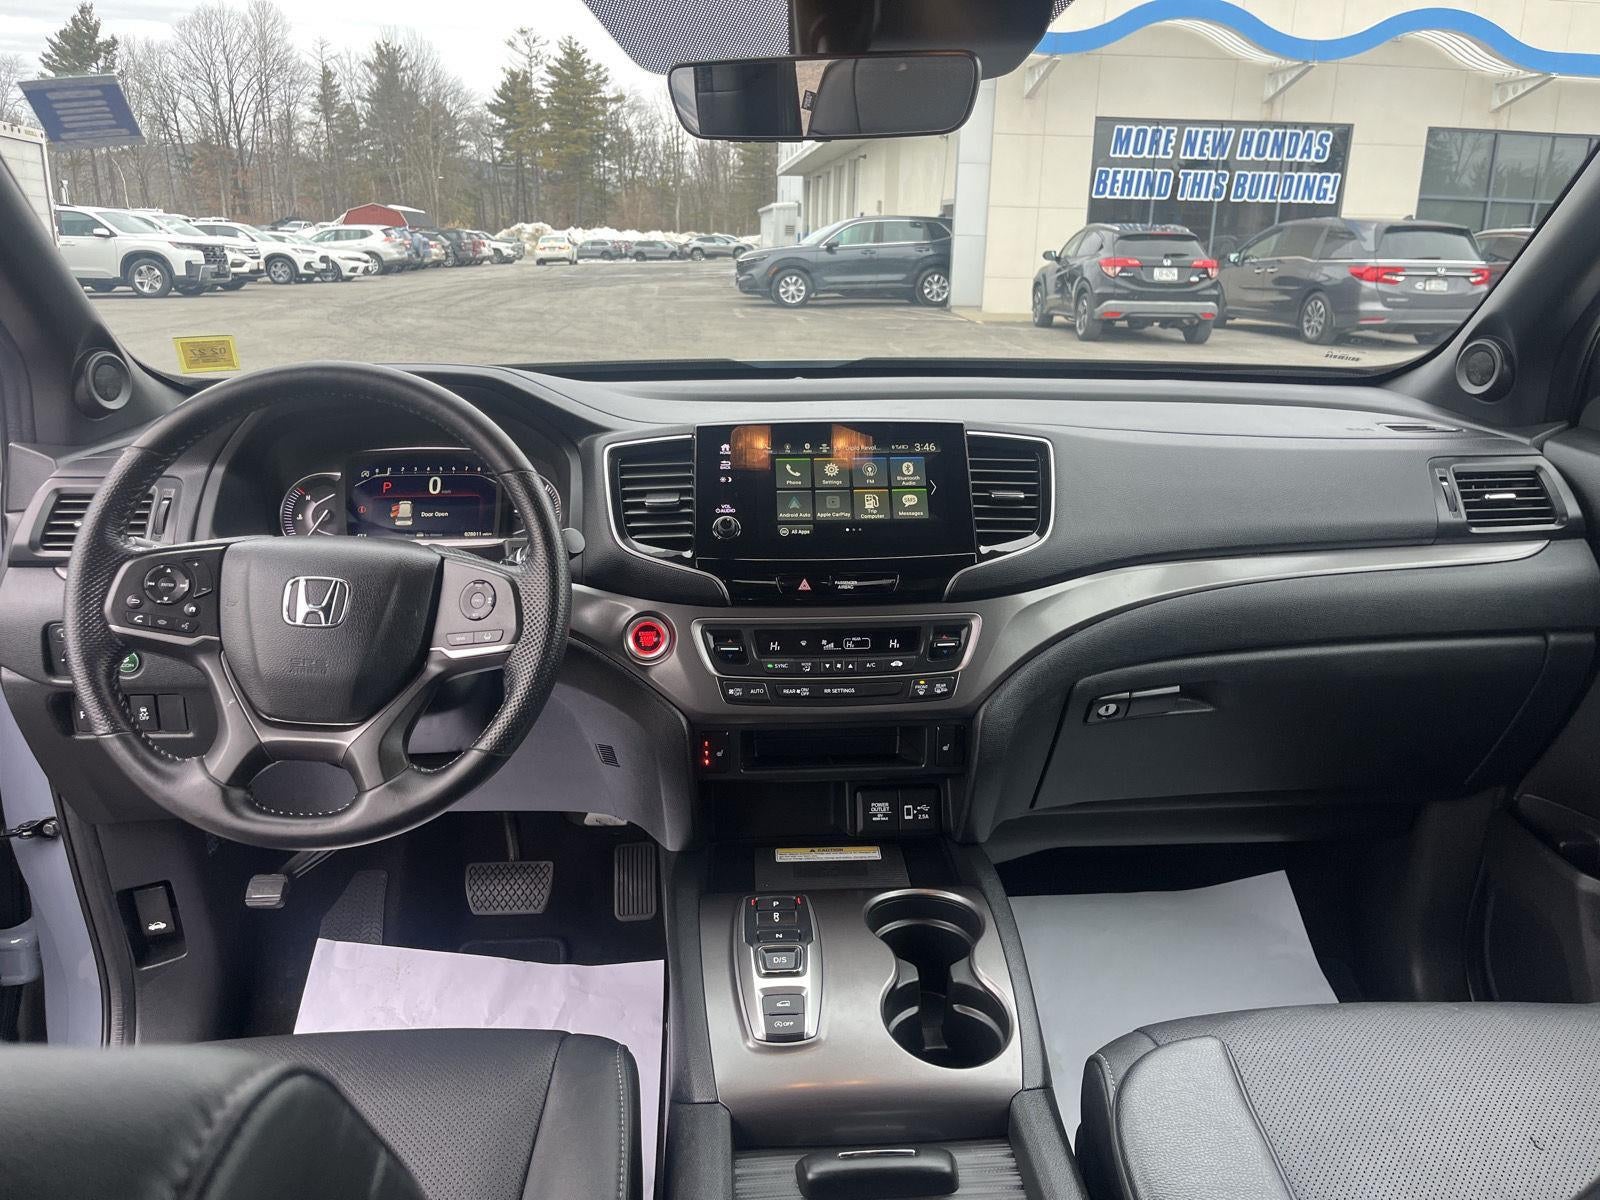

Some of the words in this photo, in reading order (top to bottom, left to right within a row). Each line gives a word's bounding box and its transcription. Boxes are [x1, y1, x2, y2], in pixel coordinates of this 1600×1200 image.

[1110, 125, 1177, 158] MORE
[1180, 127, 1235, 160] NEW
[1236, 128, 1333, 163] HONDAS
[1092, 167, 1173, 199] BEHIND
[1177, 169, 1228, 202] THIS
[1230, 171, 1341, 204] BUILDING!
[914, 443, 936, 452] 3:46
[382, 481, 392, 493] P
[428, 476, 442, 495] 0
[773, 956, 787, 964] D/S
